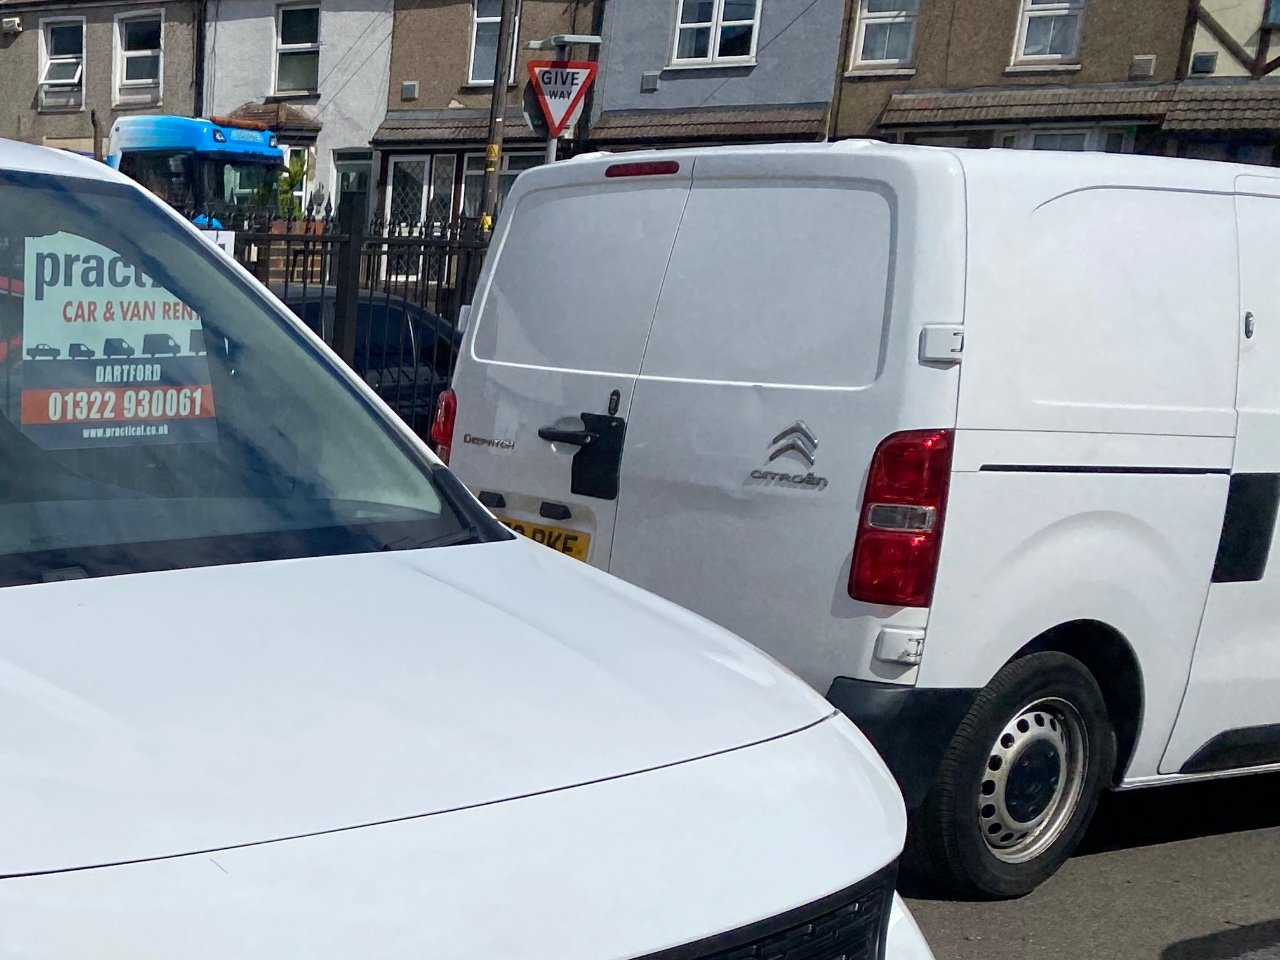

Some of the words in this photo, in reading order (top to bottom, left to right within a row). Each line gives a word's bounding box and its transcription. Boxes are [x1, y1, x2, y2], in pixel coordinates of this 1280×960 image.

[541, 70, 579, 86] GIVE
[548, 90, 573, 100] WAY
[62, 300, 97, 323] CAR
[103, 301, 115, 322] &
[120, 301, 156, 321] VAN
[95, 364, 161, 383] DARTFORD
[48, 391, 115, 421] 01322
[123, 388, 202, 417] 930061
[82, 424, 169, 439] www.practical.co.uk
